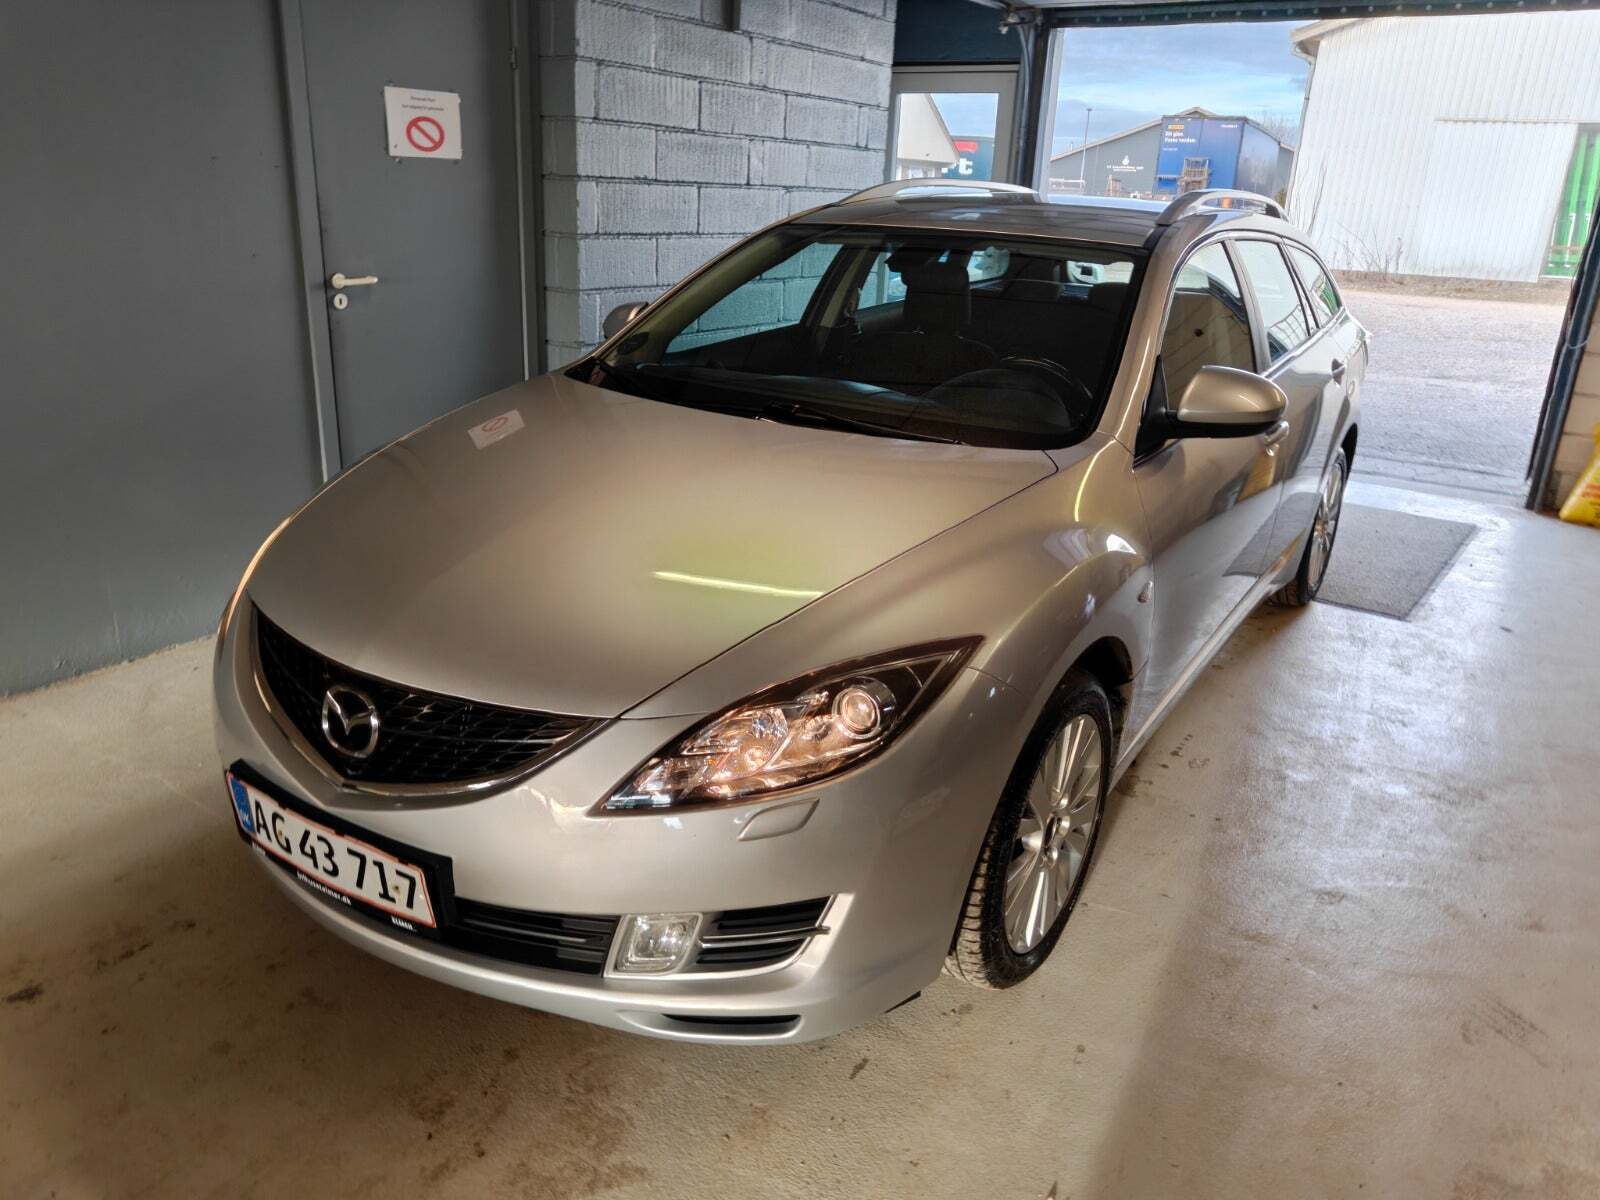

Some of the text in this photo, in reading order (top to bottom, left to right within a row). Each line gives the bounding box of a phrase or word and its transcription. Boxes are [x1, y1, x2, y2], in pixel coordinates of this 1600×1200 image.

[255, 800, 293, 855] AG
[299, 828, 340, 878] 43
[346, 849, 417, 910] 717
